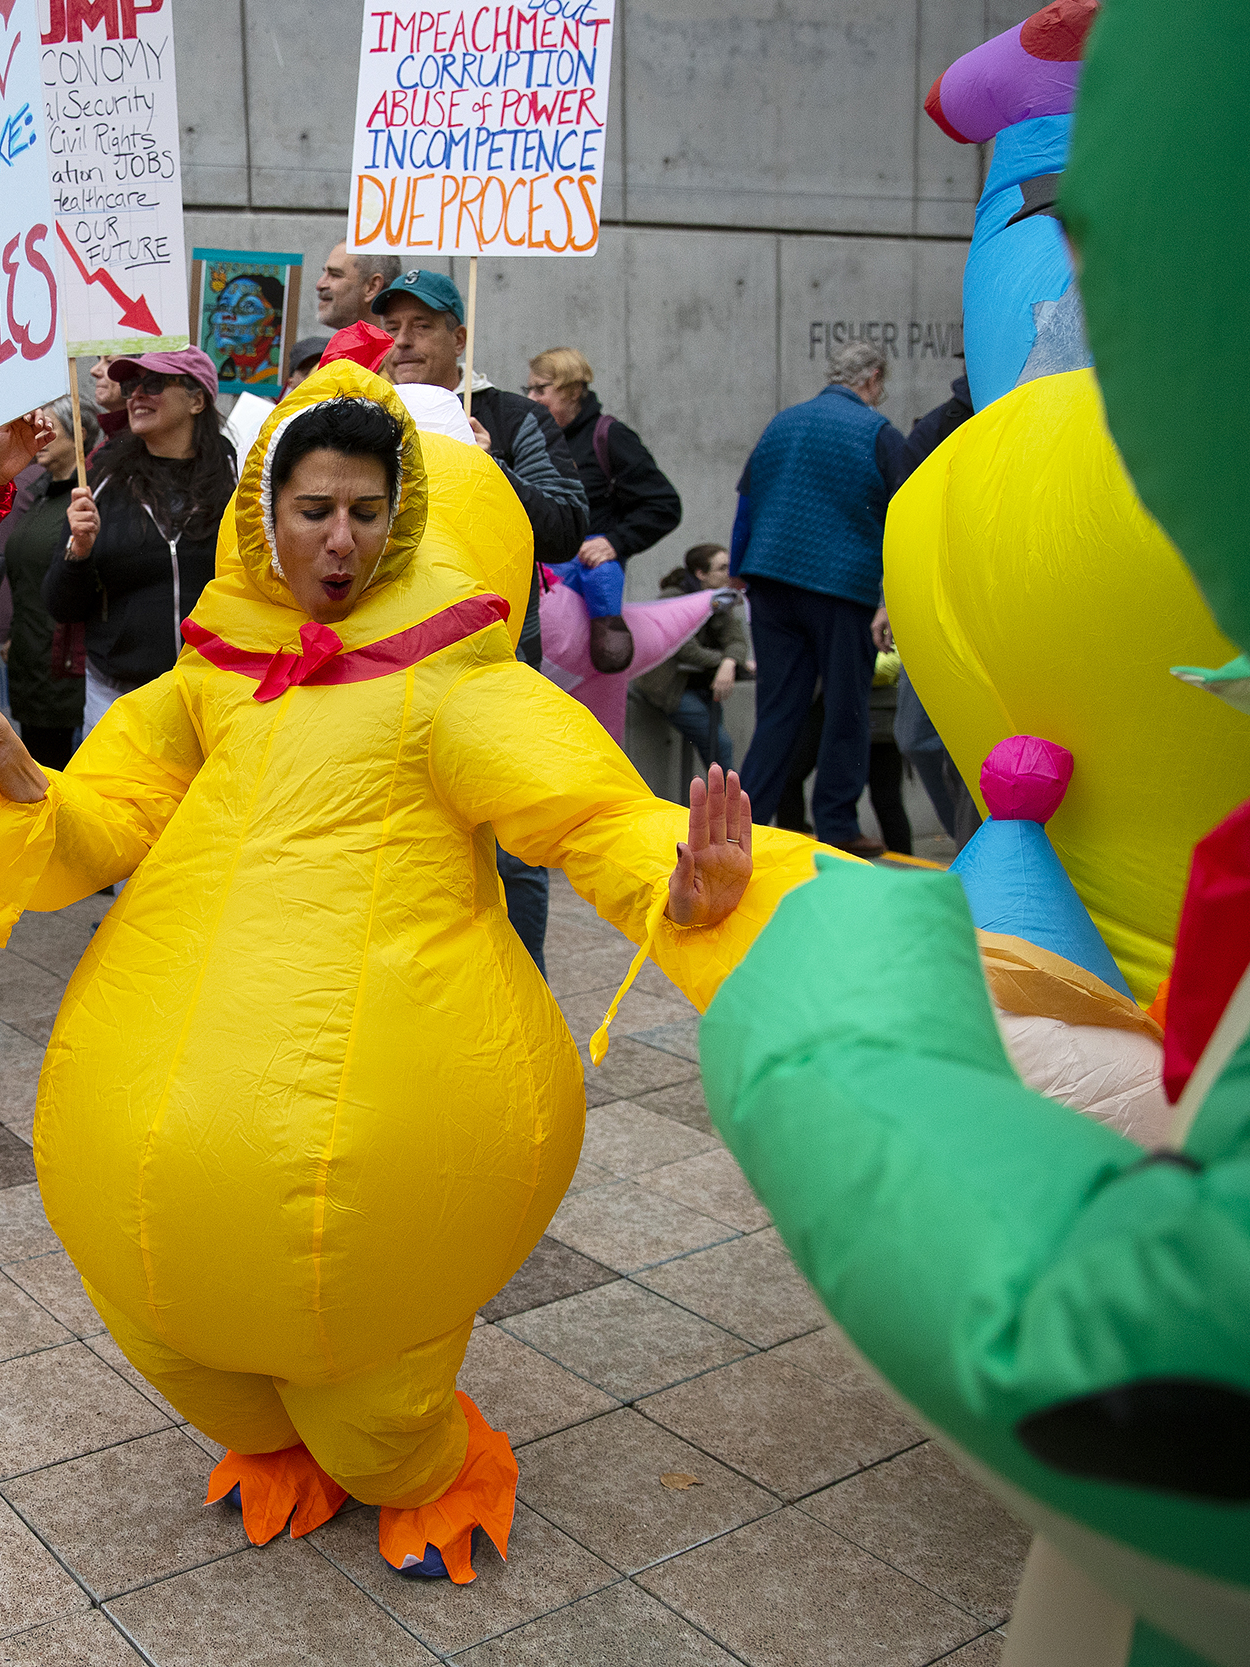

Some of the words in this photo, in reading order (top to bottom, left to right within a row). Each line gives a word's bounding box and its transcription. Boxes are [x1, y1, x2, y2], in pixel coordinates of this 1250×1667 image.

[369, 5, 610, 54] IMPEACHMENT
[396, 47, 597, 89] CORRUPTION
[63, 86, 154, 131] Security
[366, 89, 469, 128] ABUSE
[472, 92, 492, 126] of
[500, 88, 604, 127] POWER
[49, 123, 87, 154] Civil
[93, 123, 156, 165] Rights
[364, 126, 602, 172] INCOMPETENCE
[114, 151, 175, 180] JOBS
[75, 216, 119, 243] OUR
[354, 173, 435, 247] DUE
[438, 173, 599, 253] PROCESS
[86, 237, 171, 267] FUTURE
